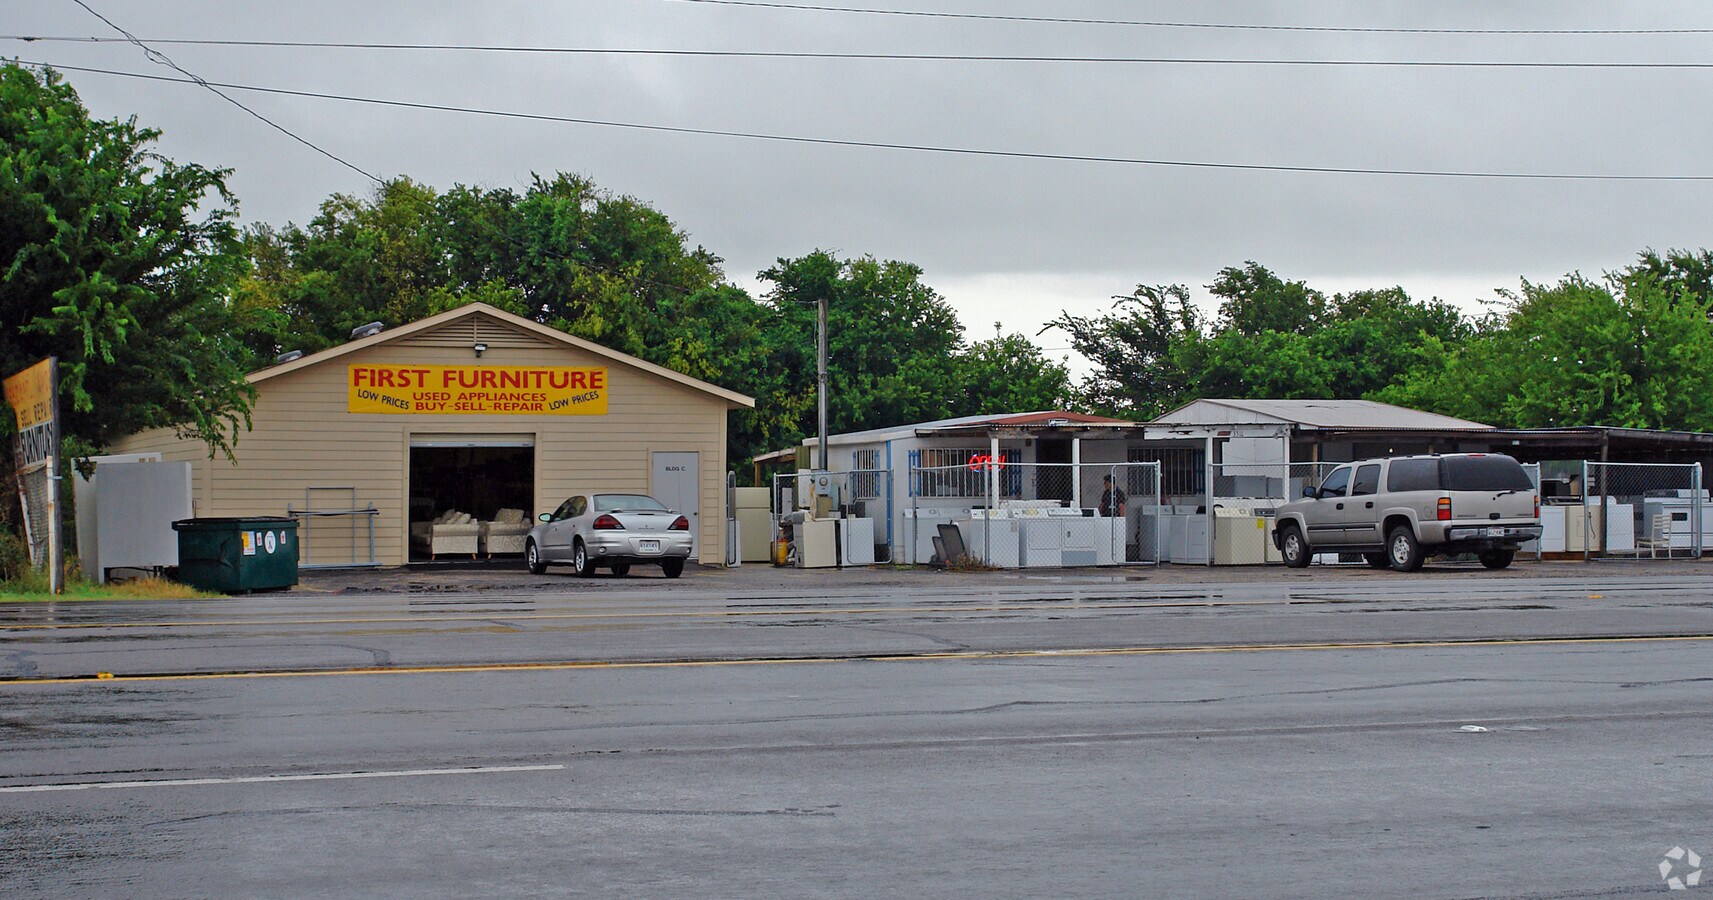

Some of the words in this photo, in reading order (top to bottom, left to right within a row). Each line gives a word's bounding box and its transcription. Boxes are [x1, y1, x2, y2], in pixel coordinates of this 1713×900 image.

[353, 368, 431, 388] FIRST
[443, 369, 603, 390] FURNITURE
[357, 388, 379, 402] LOW
[381, 394, 409, 410] PRICES
[412, 392, 451, 401] USED
[457, 392, 547, 402] APPLIANCES
[415, 401, 544, 412] BUY-SELL-REPAIR
[548, 398, 569, 411] LOW
[571, 390, 599, 405] PRICES
